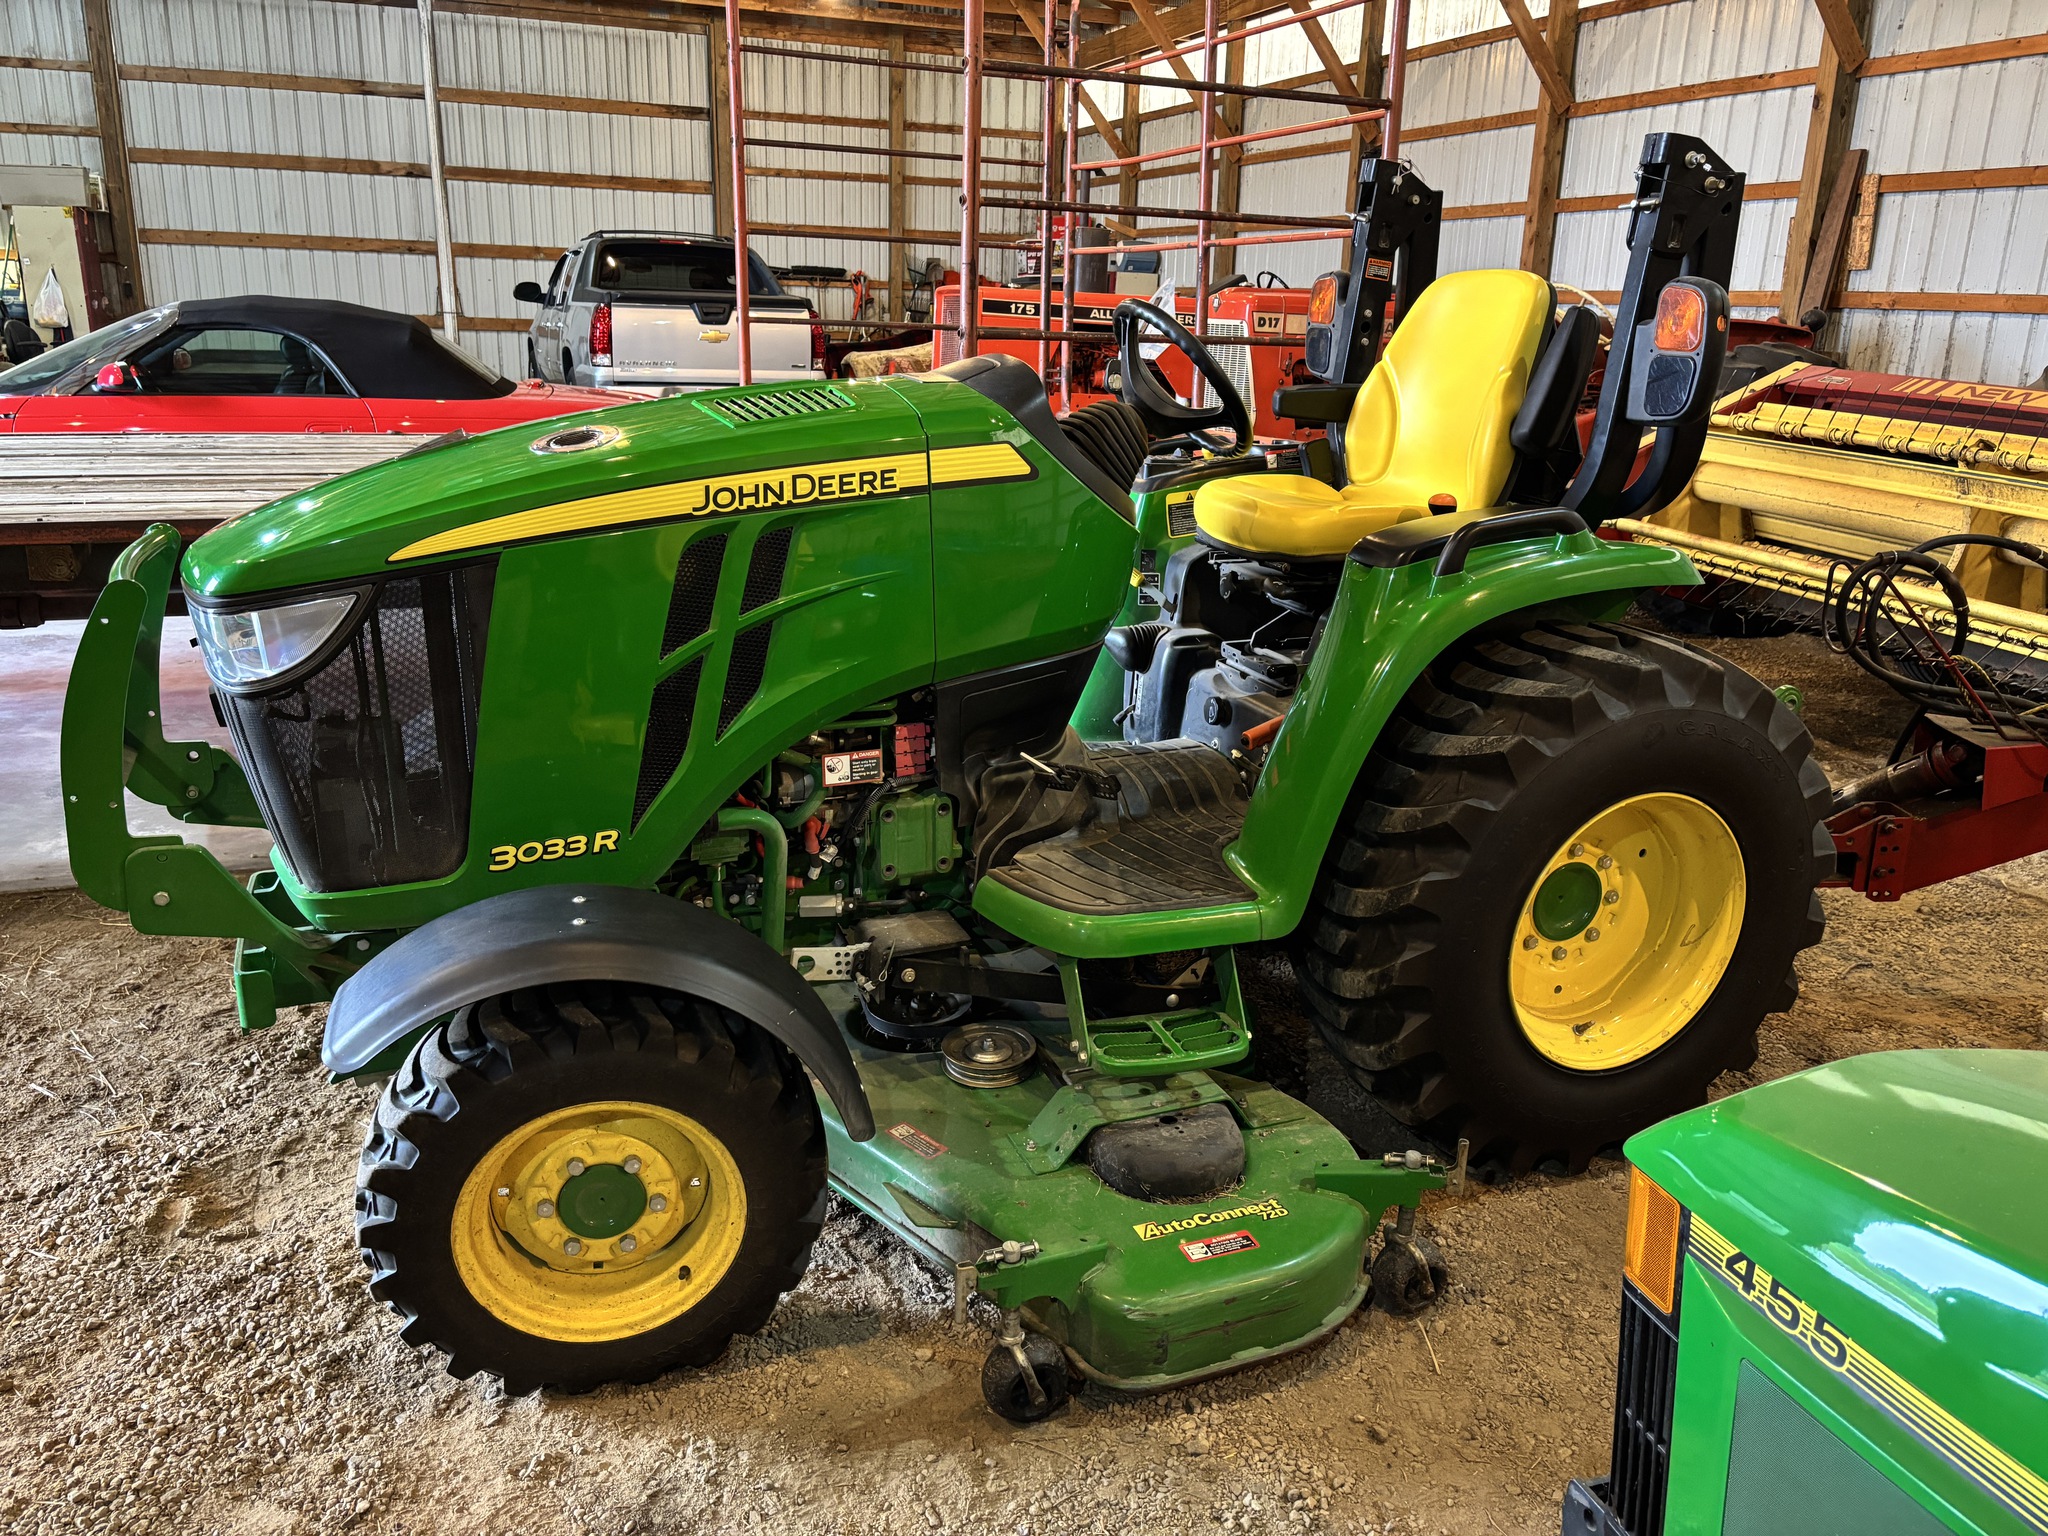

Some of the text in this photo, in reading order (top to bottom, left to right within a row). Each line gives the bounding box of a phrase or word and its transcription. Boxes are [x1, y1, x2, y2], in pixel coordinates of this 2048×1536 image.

[1009, 303, 1036, 315] 175
[1090, 309, 1114, 320] ALL
[1957, 386, 2048, 403] NEW
[692, 468, 898, 513] JOHN DEERE
[488, 829, 621, 873] 3033 R
[1143, 1198, 1284, 1240] AutoConnect
[1257, 1207, 1289, 1221] 72D
[1724, 1250, 1849, 1371] 455
